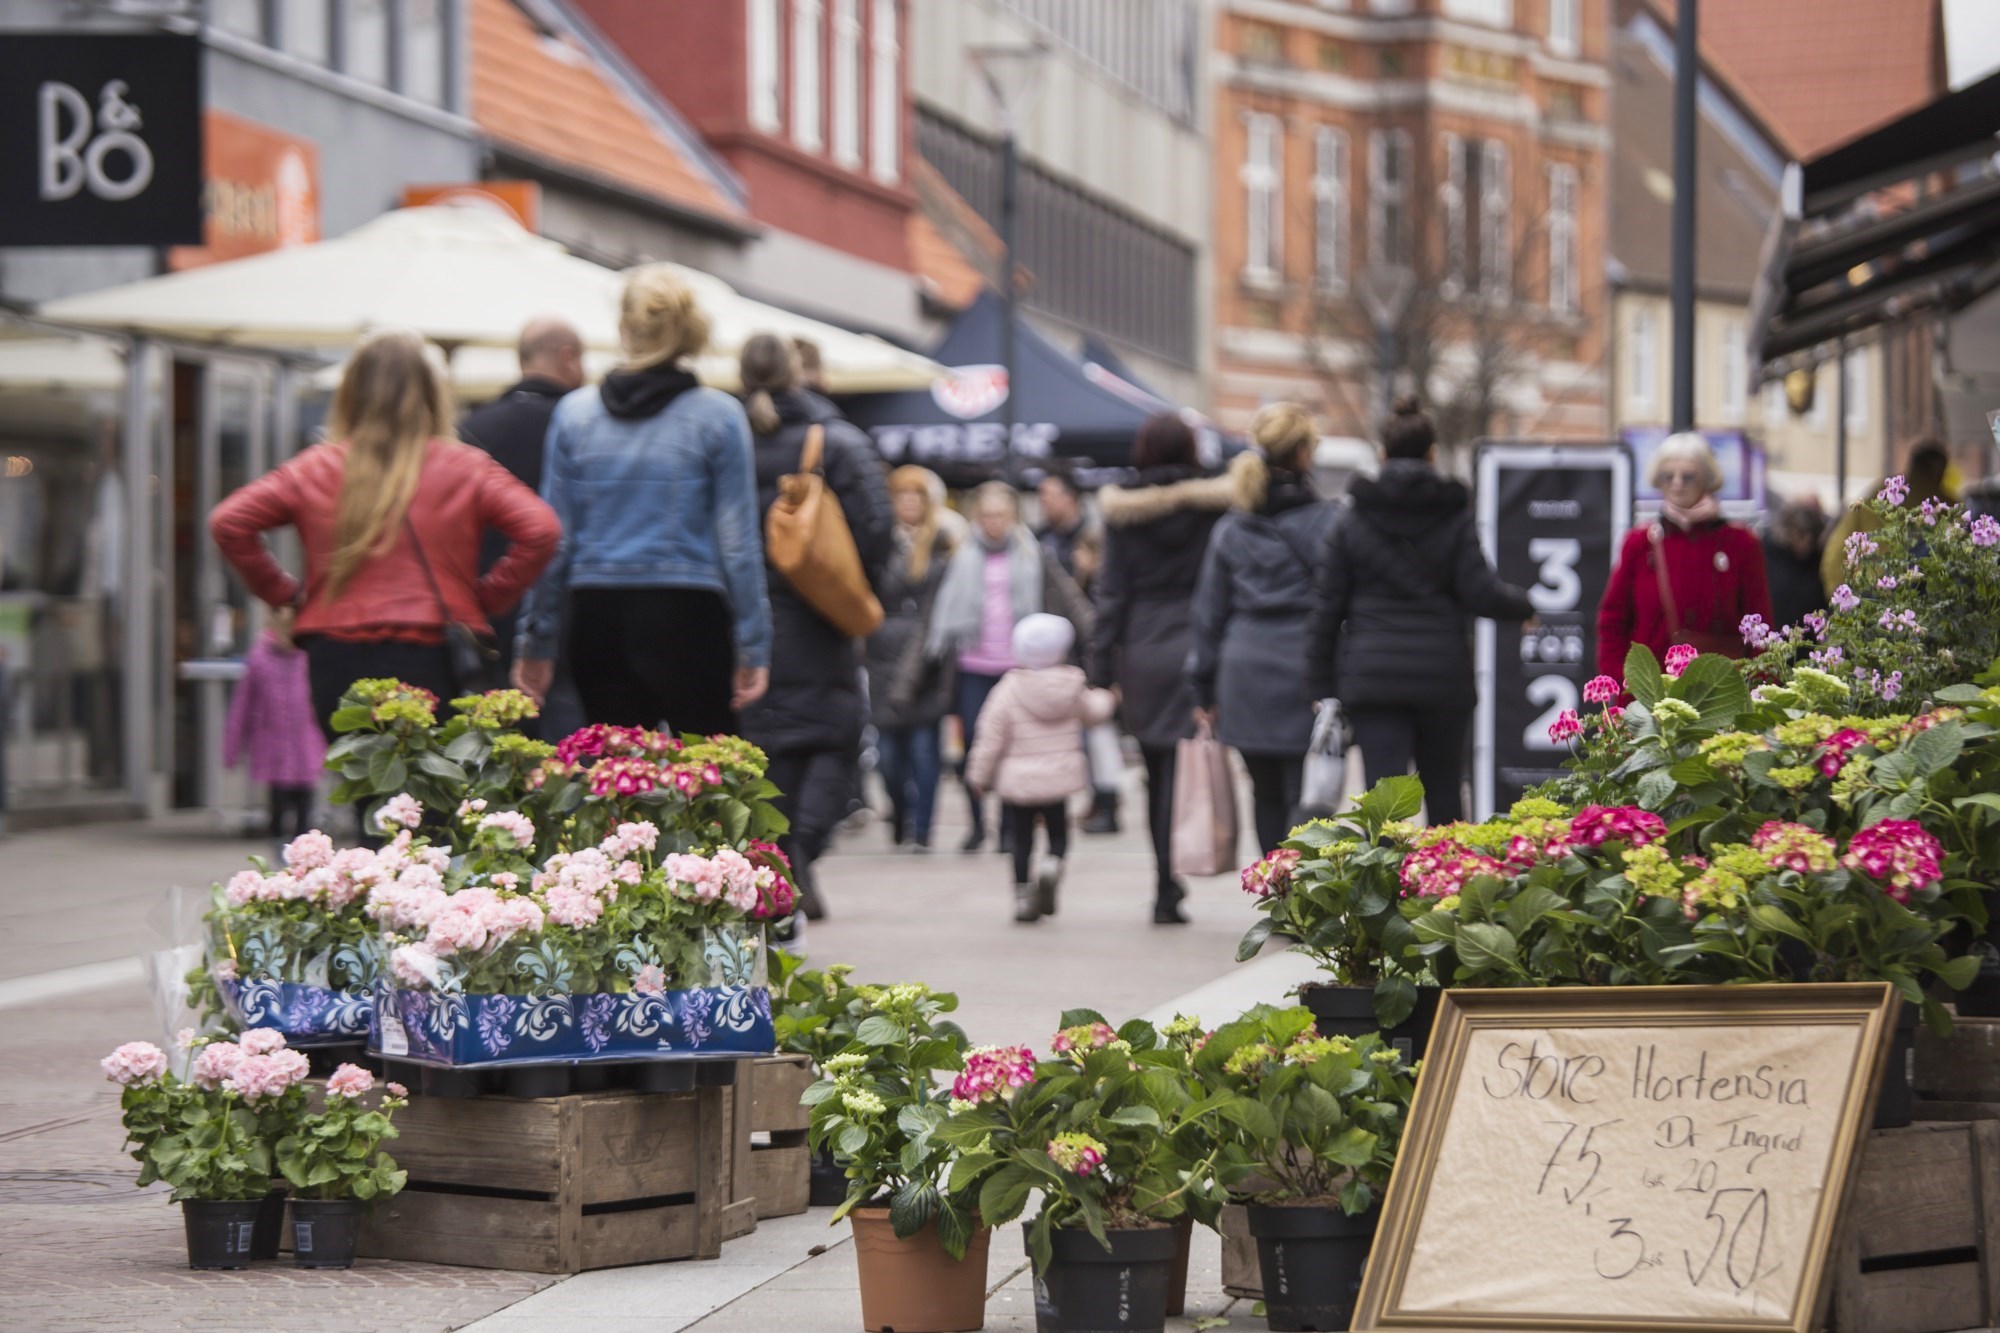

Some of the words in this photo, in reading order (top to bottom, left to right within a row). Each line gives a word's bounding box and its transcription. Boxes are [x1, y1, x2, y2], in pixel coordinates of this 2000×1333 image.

[869, 422, 1060, 459] TREK
[1527, 537, 1581, 613] 3
[1520, 635, 1584, 662] FOR
[1523, 674, 1580, 750] 2
[1483, 1040, 1605, 1104] Store
[1673, 1158, 1718, 1193] 20
